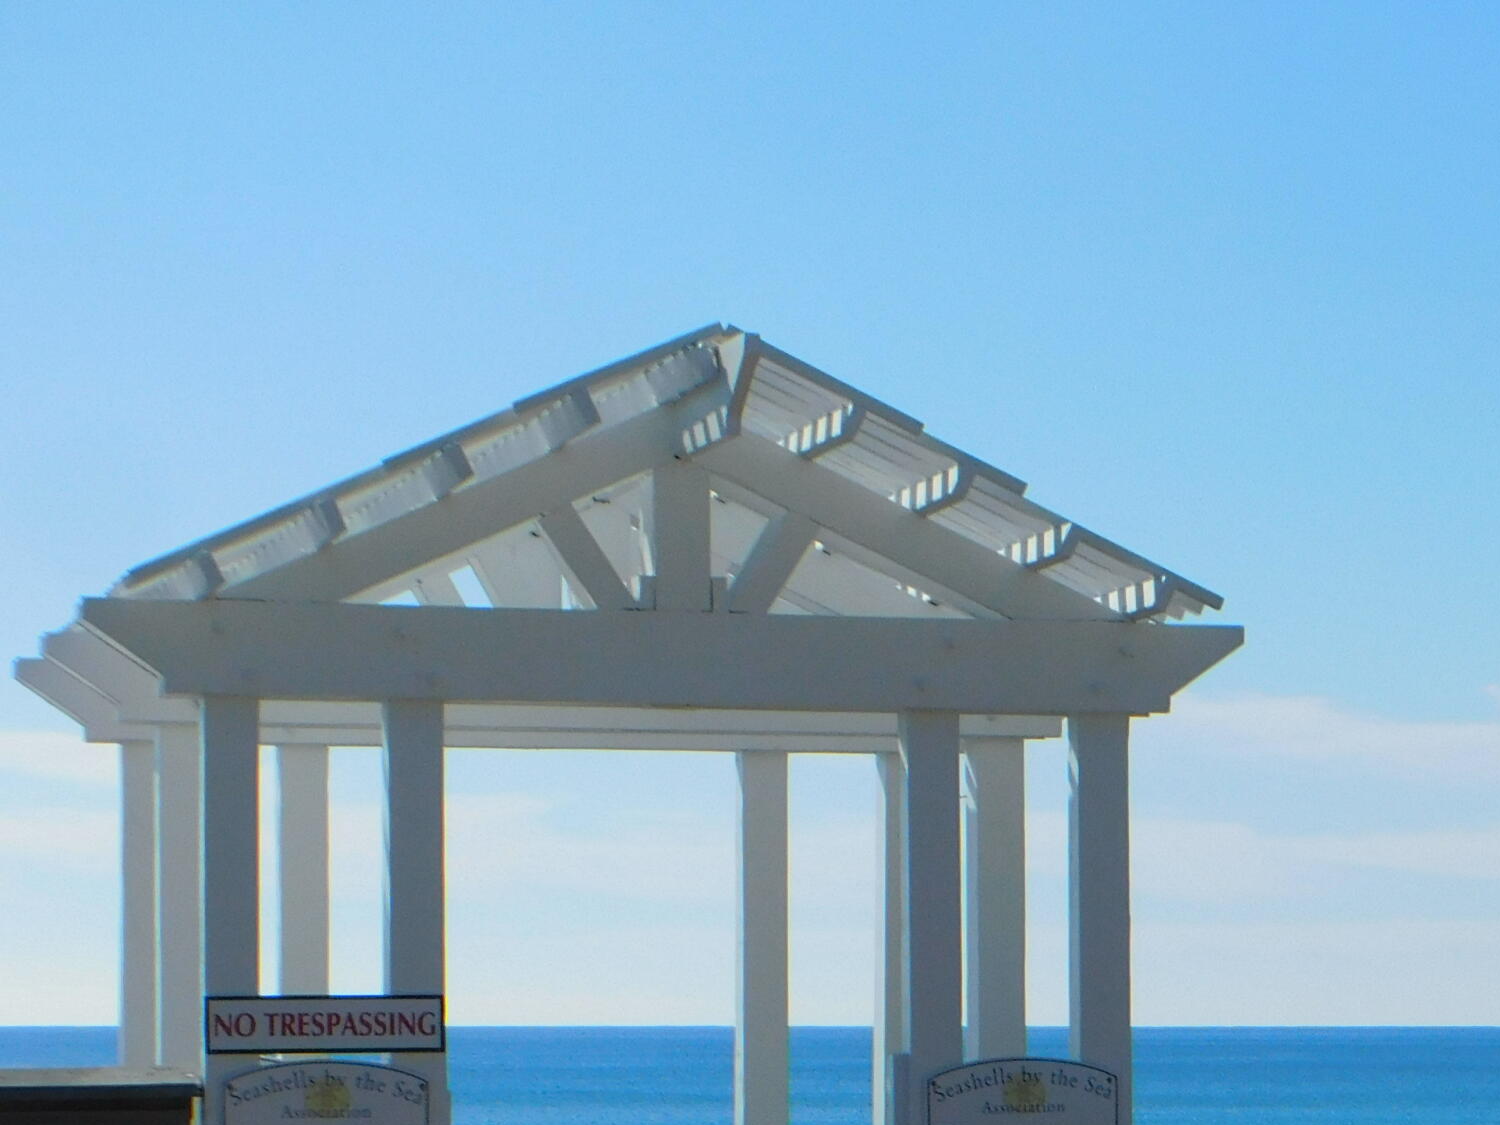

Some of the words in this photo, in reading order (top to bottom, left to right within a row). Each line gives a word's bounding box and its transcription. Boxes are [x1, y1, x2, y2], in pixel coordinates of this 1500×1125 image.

[213, 1012, 257, 1038] NO
[264, 1011, 437, 1038] TRESPASSING
[228, 1071, 317, 1106] Seashells
[324, 1069, 347, 1088] by
[355, 1072, 387, 1093] the
[391, 1082, 425, 1106] Sea
[933, 1067, 1014, 1103] Seashells
[1020, 1065, 1042, 1084] by
[1051, 1069, 1079, 1088] the
[1083, 1076, 1113, 1100] Sea
[280, 1105, 373, 1119] Association
[980, 1101, 1067, 1115] Association
